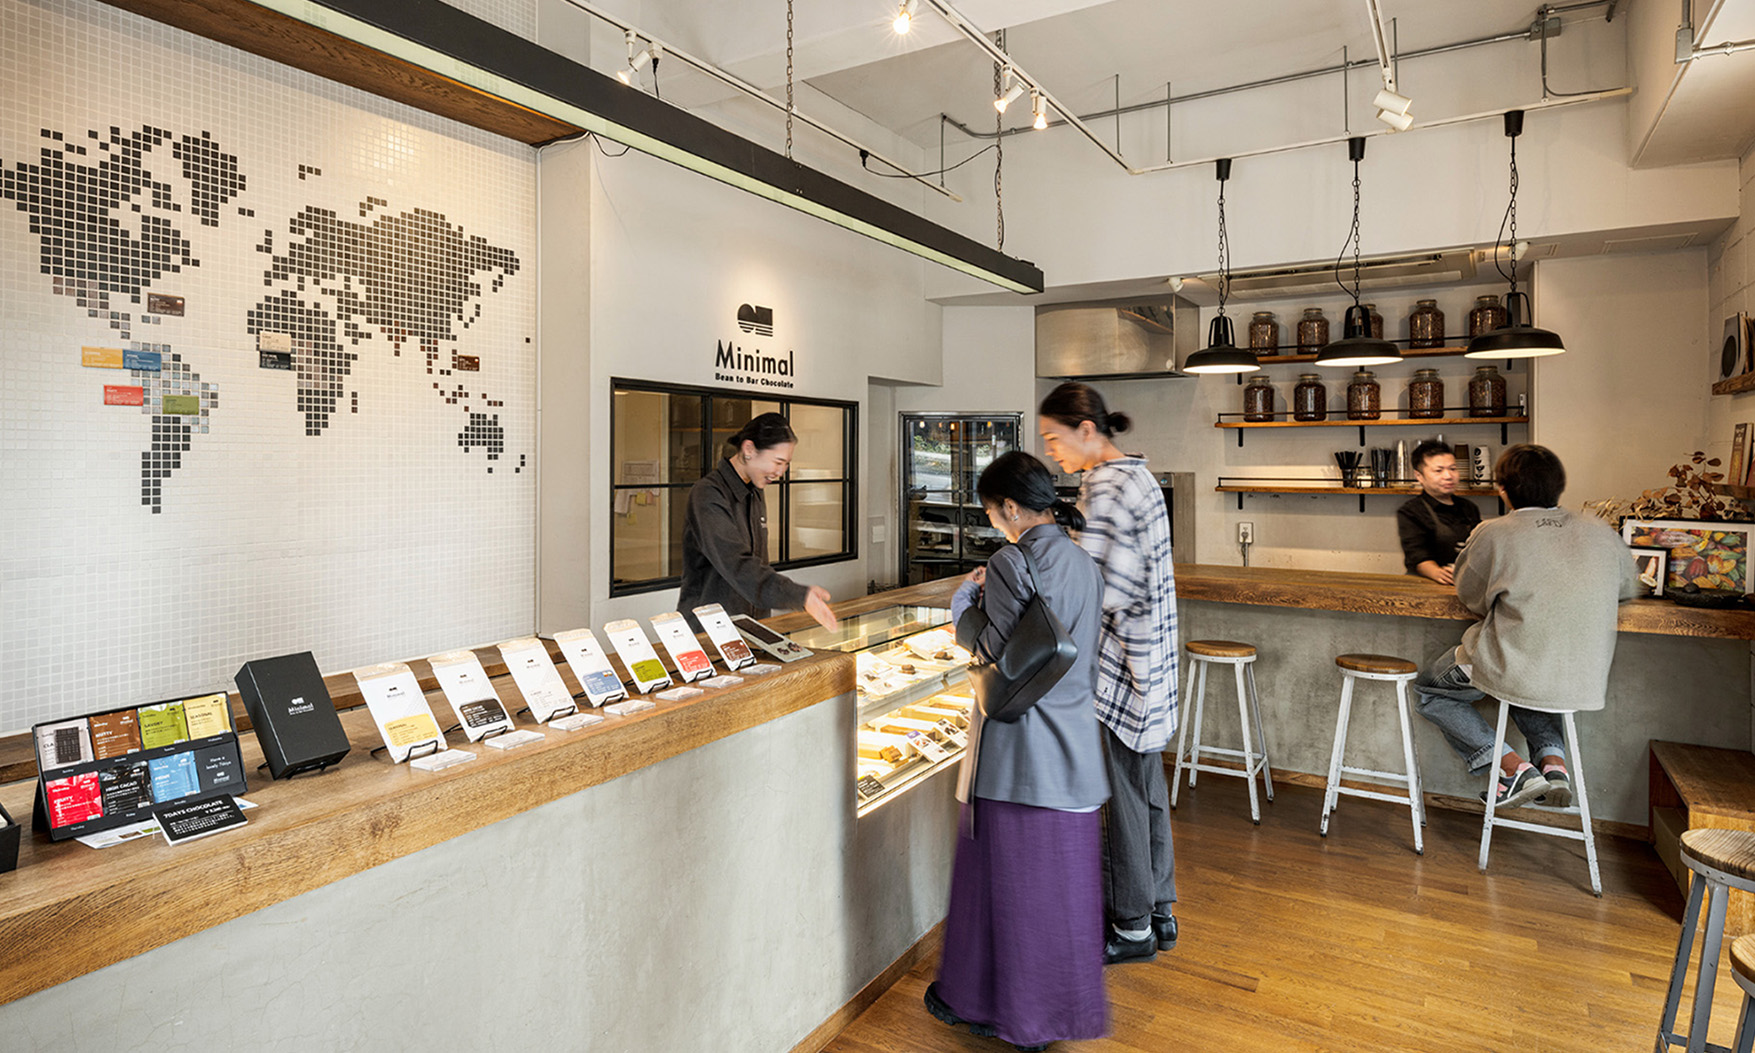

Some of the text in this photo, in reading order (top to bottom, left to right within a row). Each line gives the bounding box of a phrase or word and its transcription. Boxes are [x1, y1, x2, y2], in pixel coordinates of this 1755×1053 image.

[715, 339, 794, 377] Minimal
[715, 372, 794, 389] Bean to Bar Chocolate
[186, 799, 224, 814] CHOCOLATE
